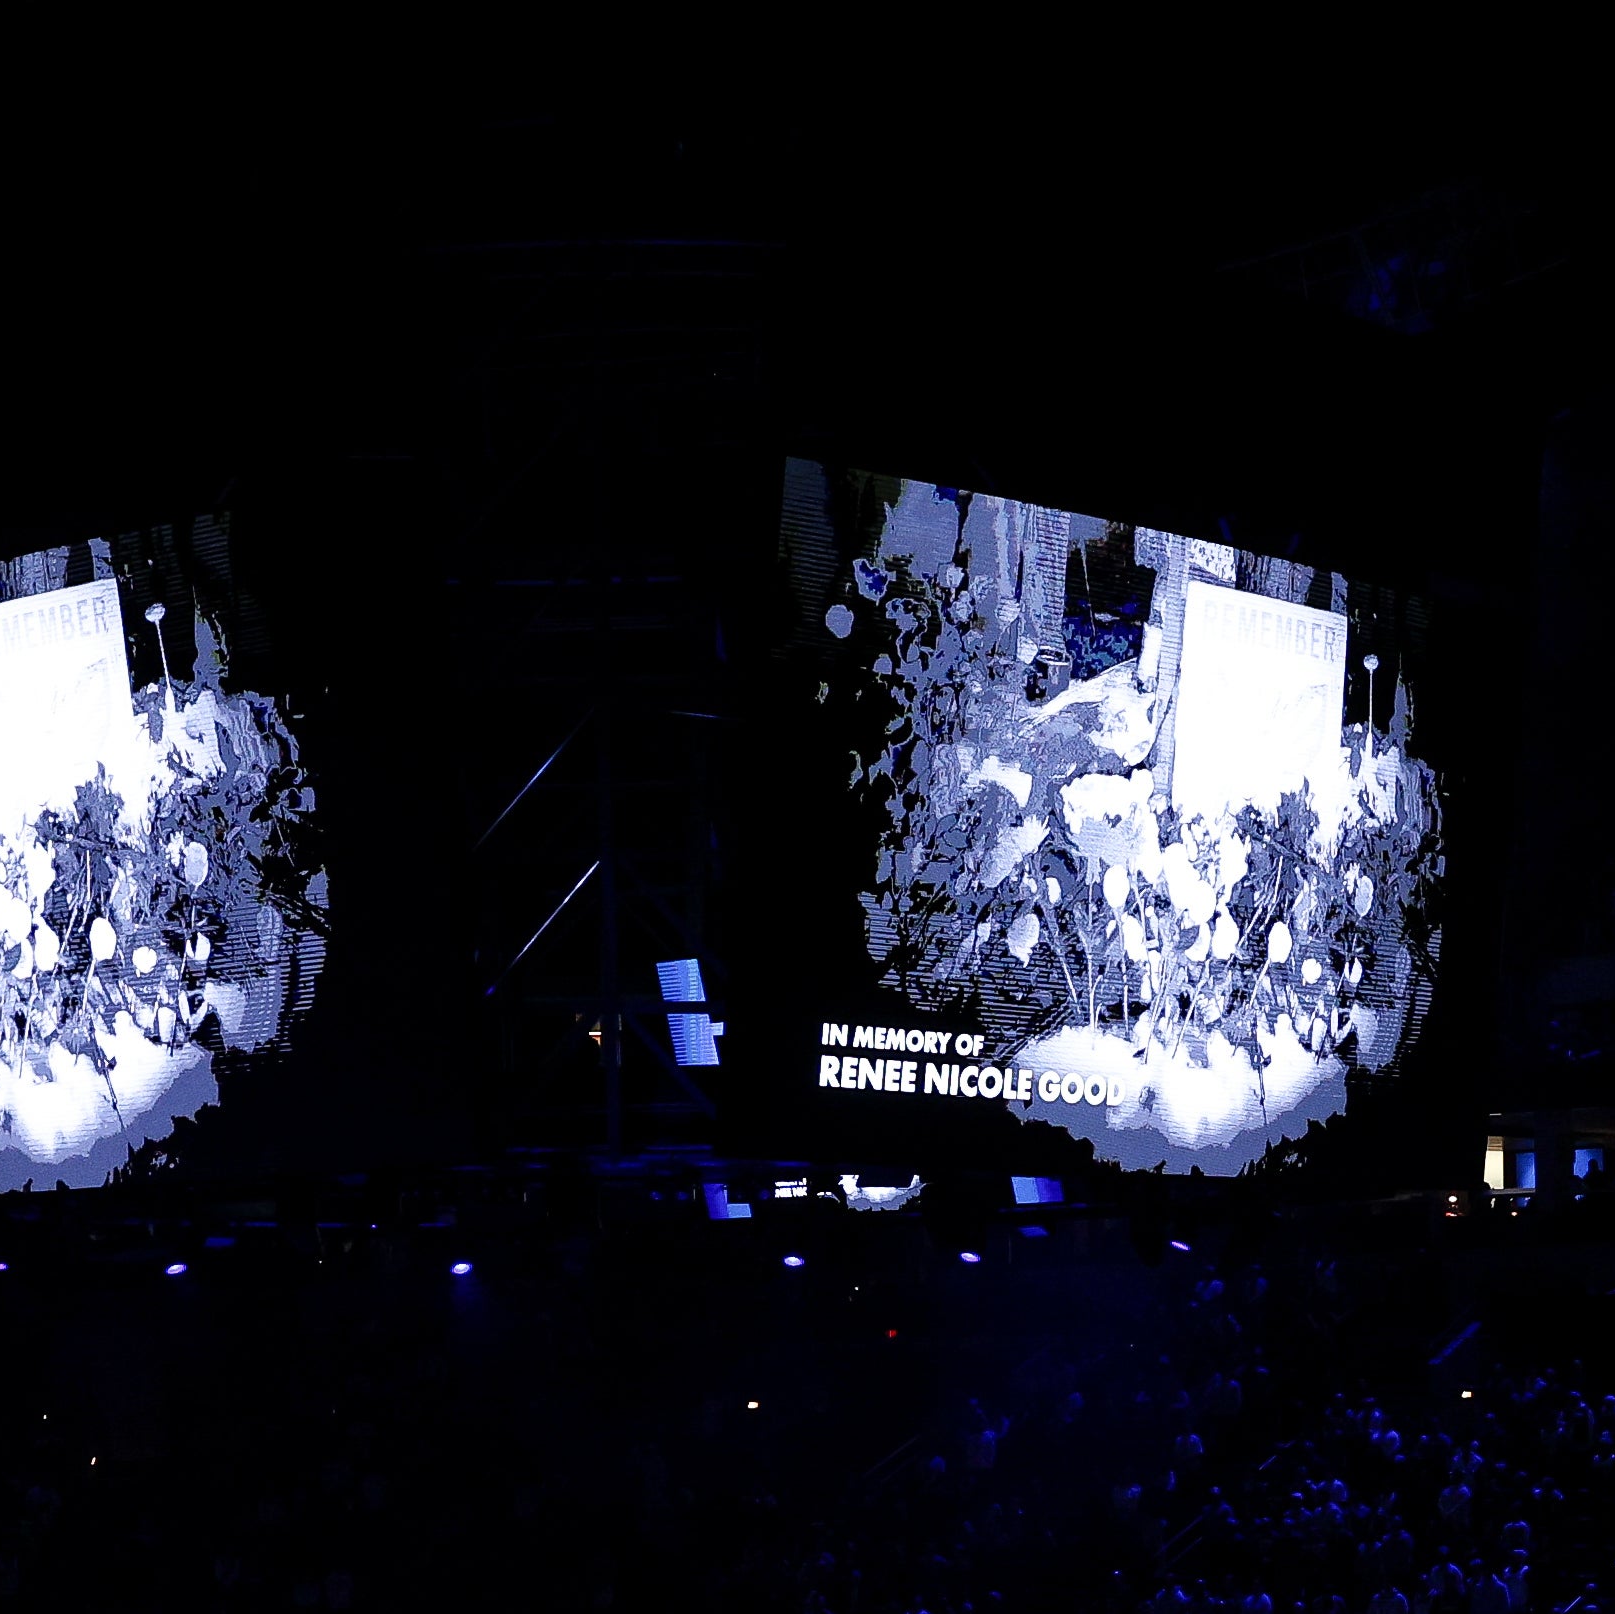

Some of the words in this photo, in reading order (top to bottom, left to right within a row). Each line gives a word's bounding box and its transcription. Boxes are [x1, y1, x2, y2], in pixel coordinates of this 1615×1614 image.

[821, 1022, 849, 1047] IN
[852, 1026, 953, 1055] MEMORY
[954, 1032, 984, 1057] OF
[819, 1055, 918, 1093] RENEE
[923, 1062, 1033, 1101] NICOLE
[1037, 1070, 1126, 1107] GOOD
